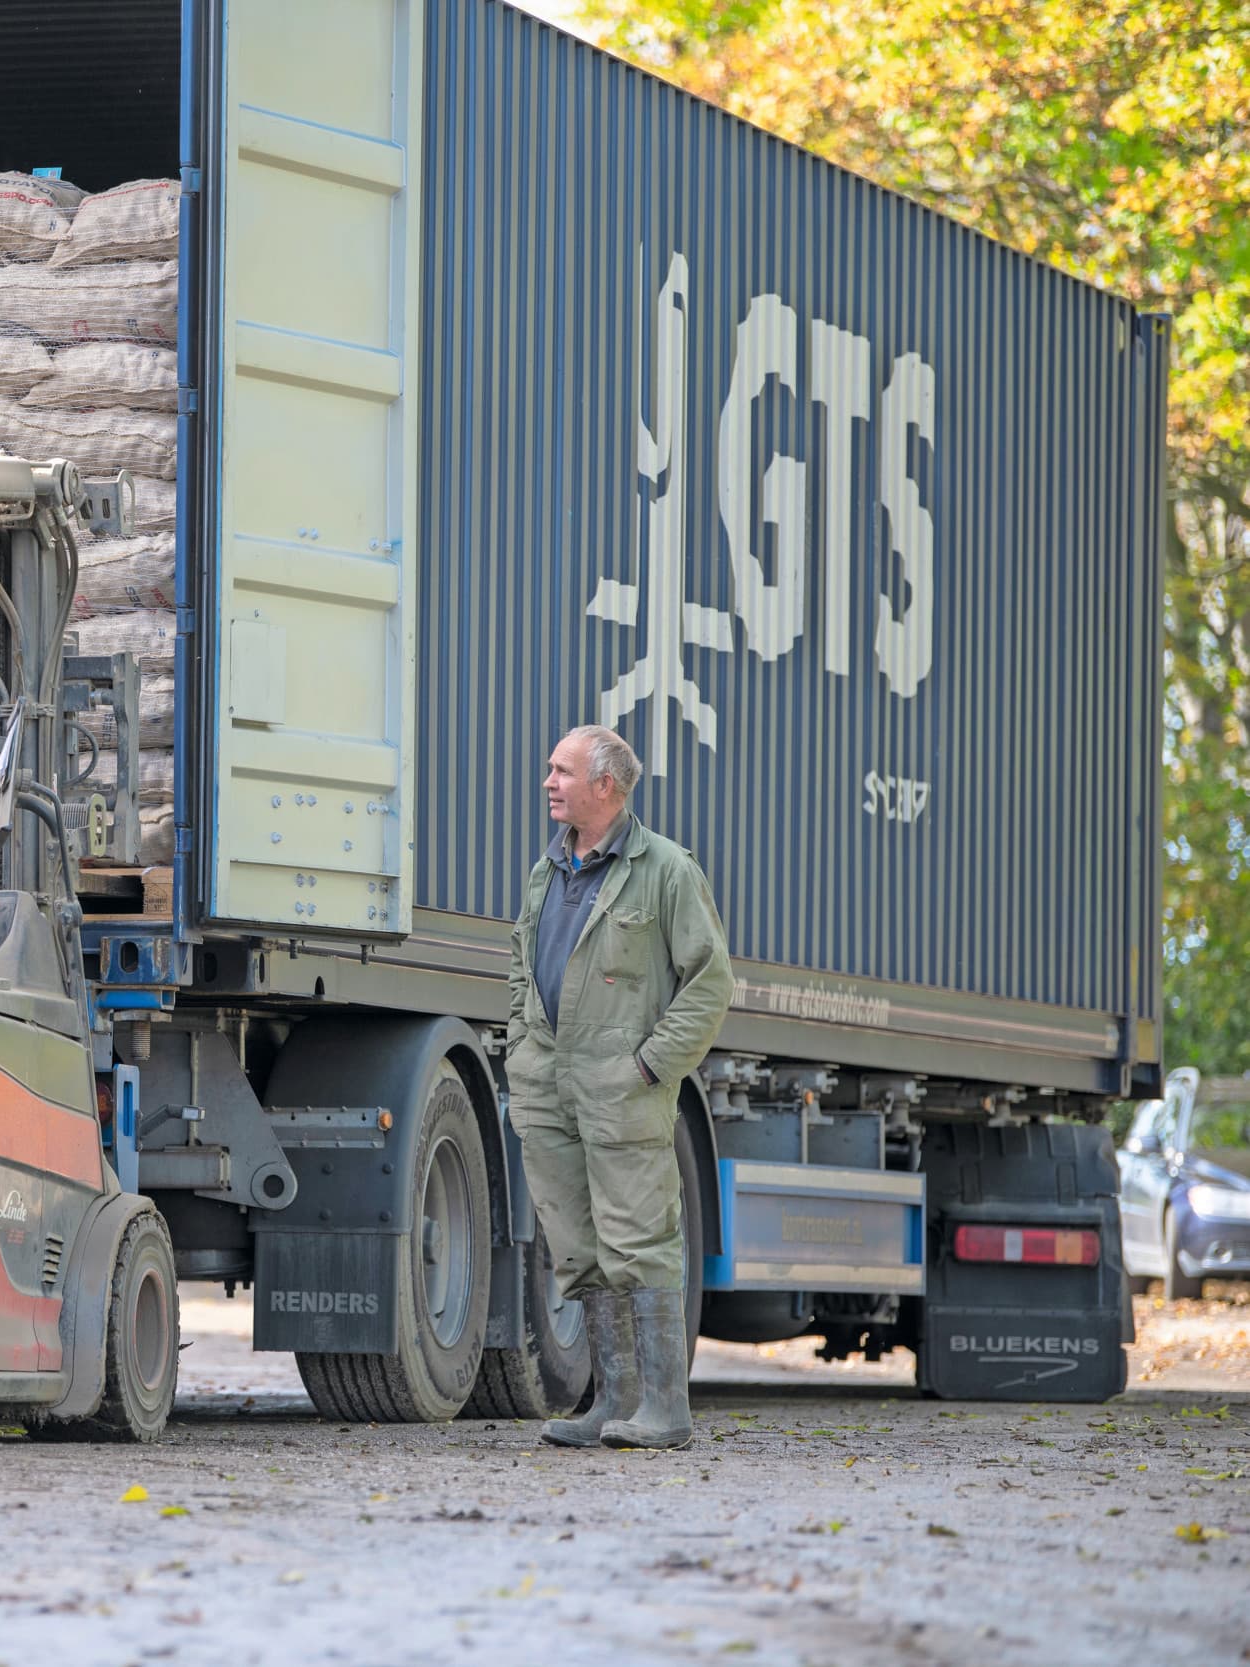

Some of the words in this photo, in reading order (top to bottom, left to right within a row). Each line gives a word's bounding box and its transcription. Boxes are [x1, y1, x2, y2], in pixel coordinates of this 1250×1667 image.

[718, 293, 936, 699] GTS
[270, 1290, 379, 1315] RENDERS
[950, 1335, 1100, 1355] BLUEKENS
